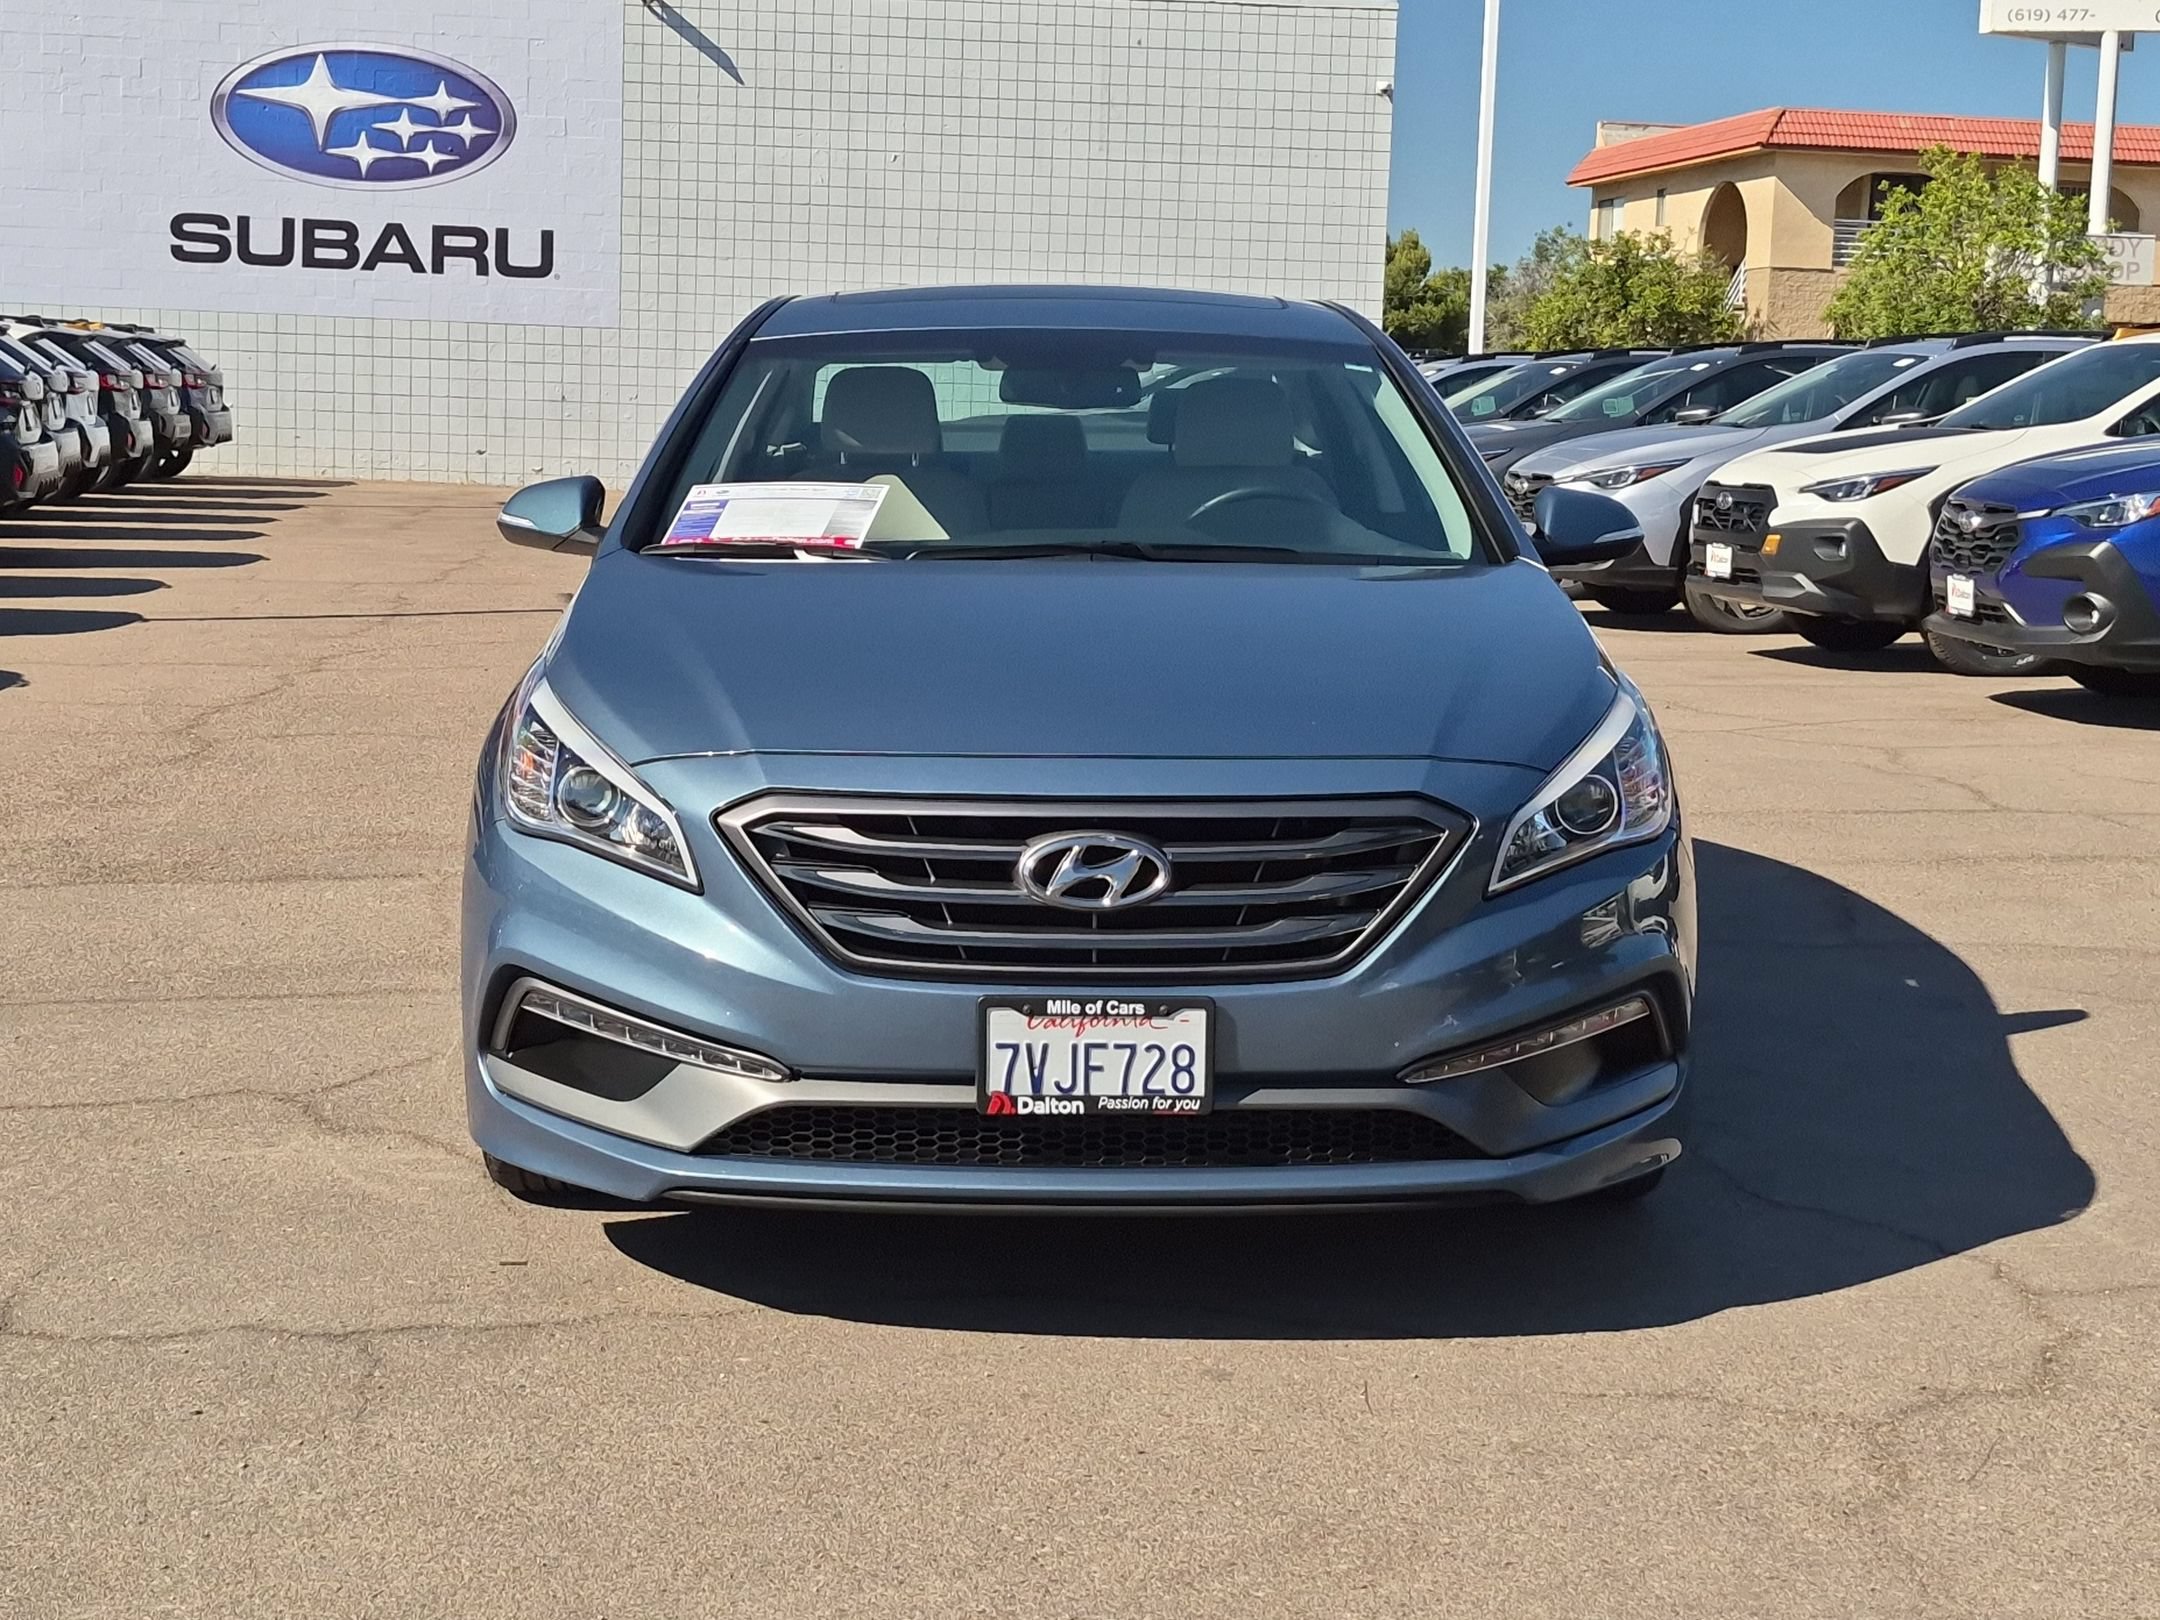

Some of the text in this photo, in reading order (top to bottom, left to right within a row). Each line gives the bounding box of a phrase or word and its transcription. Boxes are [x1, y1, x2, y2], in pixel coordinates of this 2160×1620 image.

[2007, 8, 2096, 23] (619) 477-
[169, 212, 554, 279] SUBARU
[1046, 999, 1146, 1015] Mile of Cars
[994, 1042, 1196, 1096] 7VJF728
[1017, 1095, 1200, 1115] Dalton Passion for you
